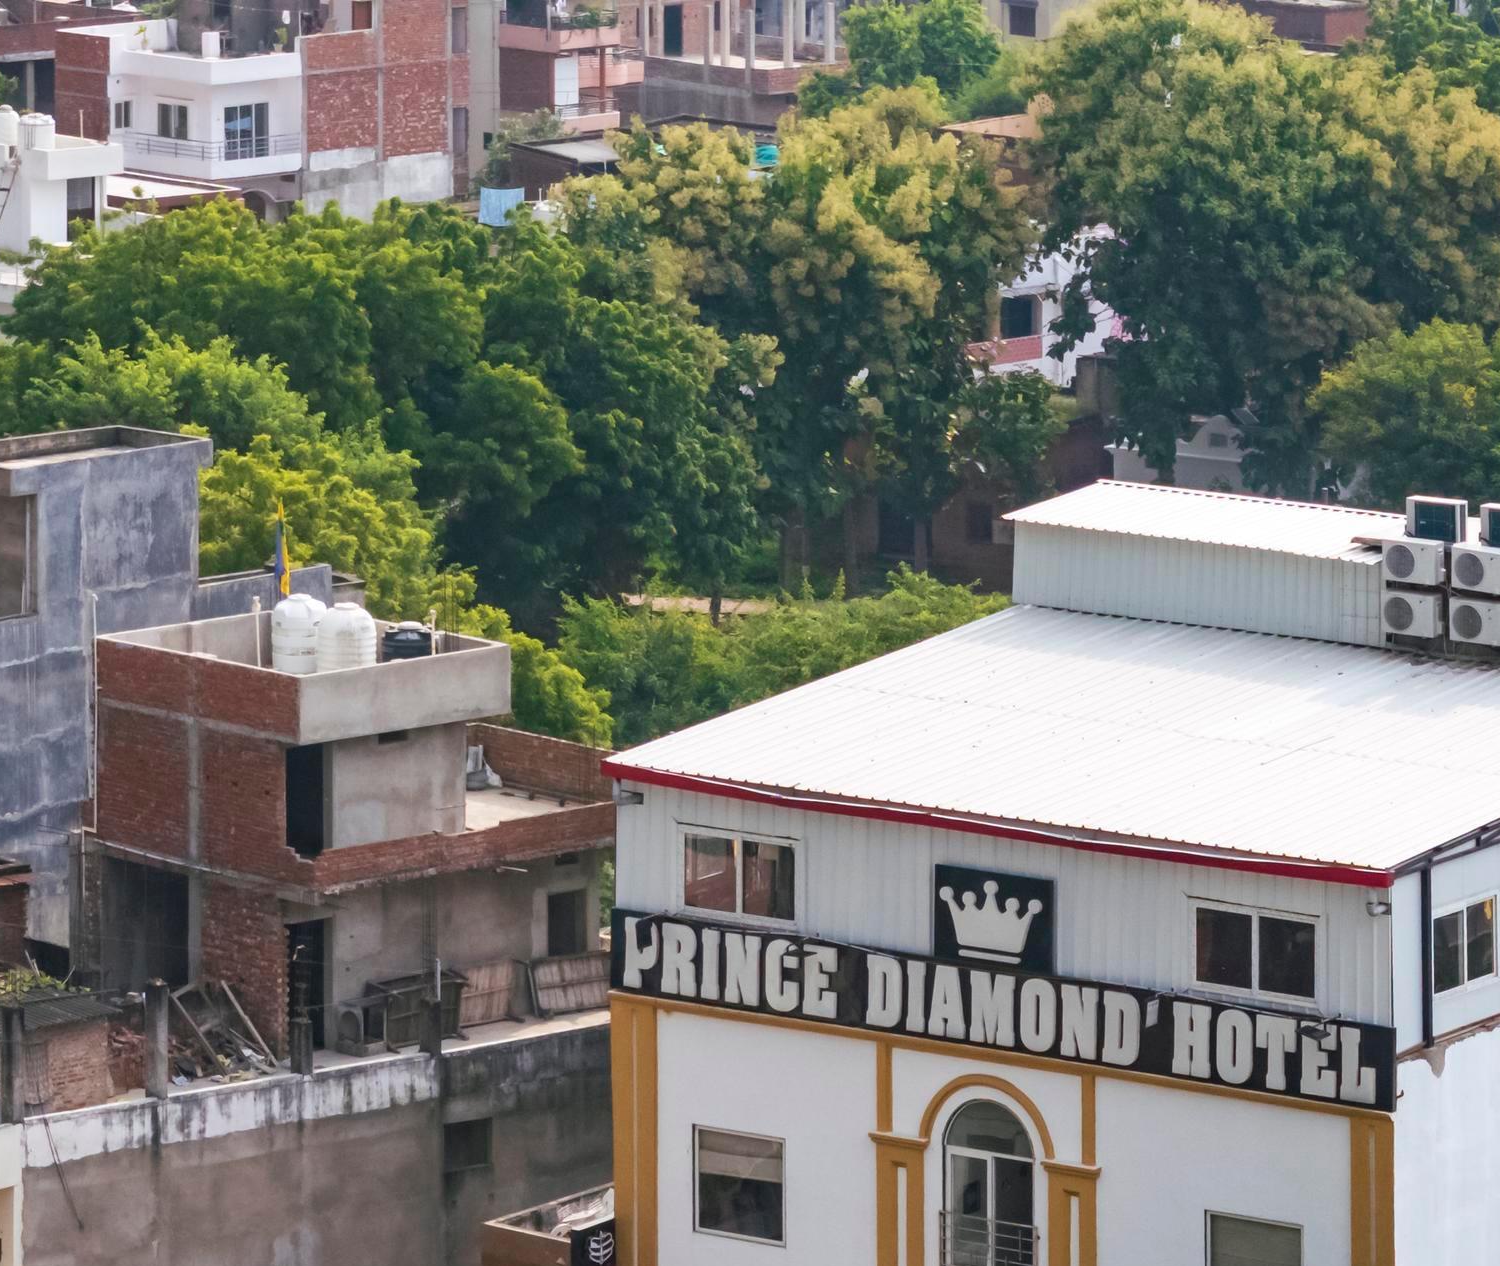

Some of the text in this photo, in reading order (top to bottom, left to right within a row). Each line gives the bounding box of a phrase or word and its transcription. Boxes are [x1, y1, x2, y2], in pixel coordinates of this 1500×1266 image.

[623, 915, 1377, 1105] PRINCE DIAMOND HOTEL
